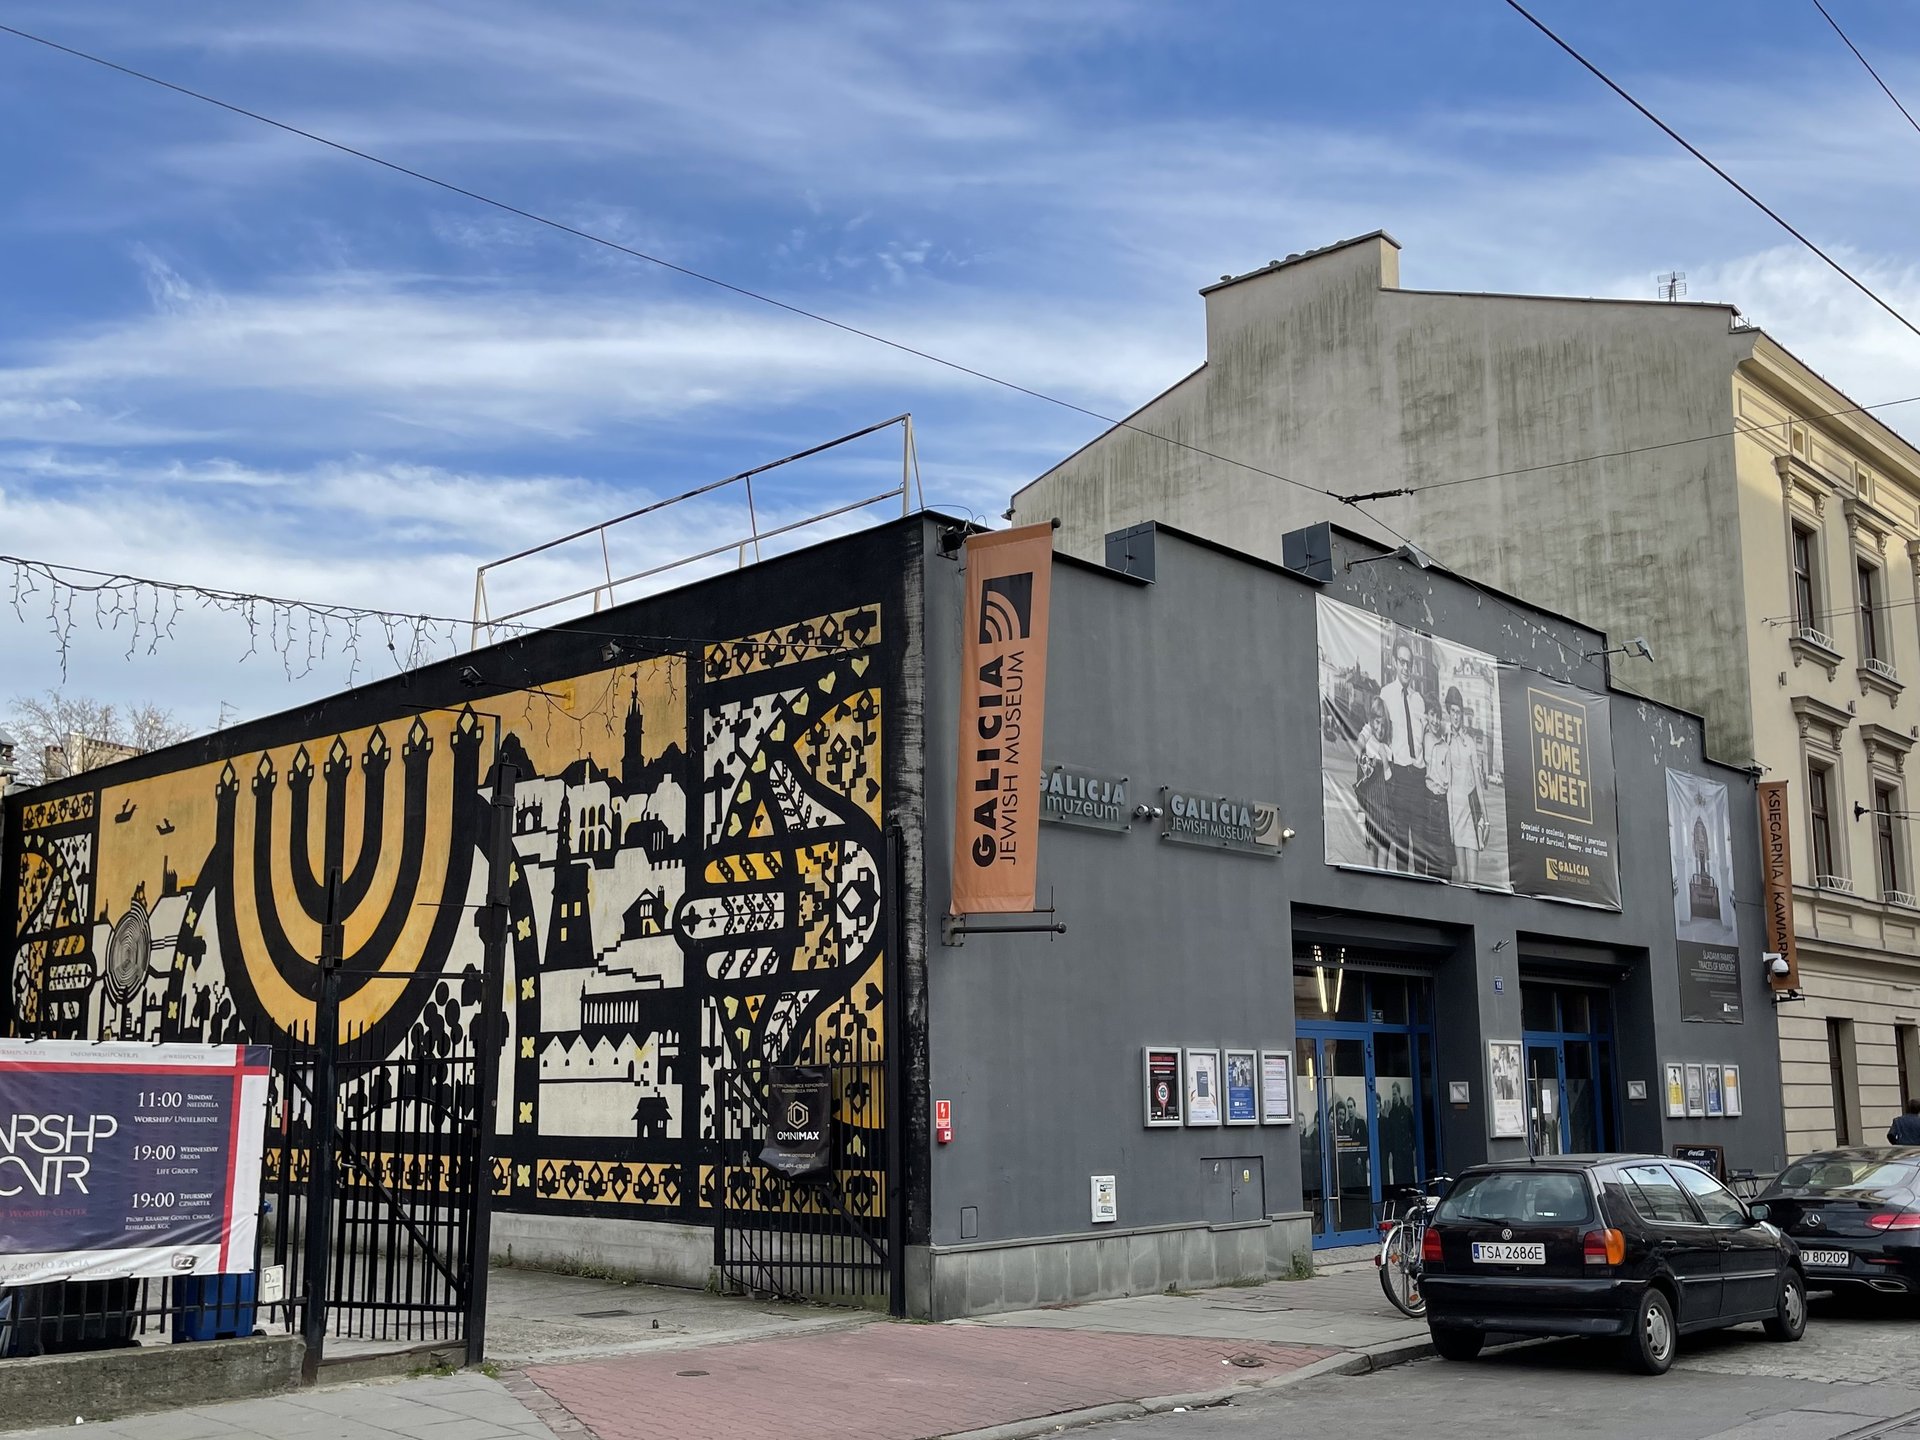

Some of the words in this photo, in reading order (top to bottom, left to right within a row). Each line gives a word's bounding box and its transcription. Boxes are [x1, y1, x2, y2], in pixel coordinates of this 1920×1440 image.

[1005, 651, 1024, 765] MUSEUM
[1534, 704, 1582, 744] SWEET
[972, 654, 1003, 867] GALICIA
[1541, 738, 1581, 775] HOME
[1039, 769, 1125, 806] GALICJA
[1538, 769, 1587, 808] SWEET
[1000, 774, 1018, 865] JEWISH
[1046, 793, 1120, 822] muzeum
[1171, 794, 1250, 828] GALICIA
[1171, 816, 1208, 836] JEWISH
[1210, 822, 1253, 843] MUSEUM
[1526, 833, 1538, 844] Story
[1767, 789, 1784, 880] KSIĘGARNIA
[1558, 860, 1590, 877] GALICJA
[1773, 891, 1791, 976] KAWIARN
[137, 1092, 182, 1108] 11:00
[777, 1131, 820, 1141] OMNIMAX
[133, 1145, 176, 1161] 19:00
[171, 1167, 199, 1175] GROUPS
[132, 1192, 175, 1209] 19:00
[1480, 1245, 1502, 1259] TSA
[1505, 1246, 1543, 1260] 2686E
[1800, 1251, 1810, 1262] D
[1812, 1251, 1847, 1264] 80209
